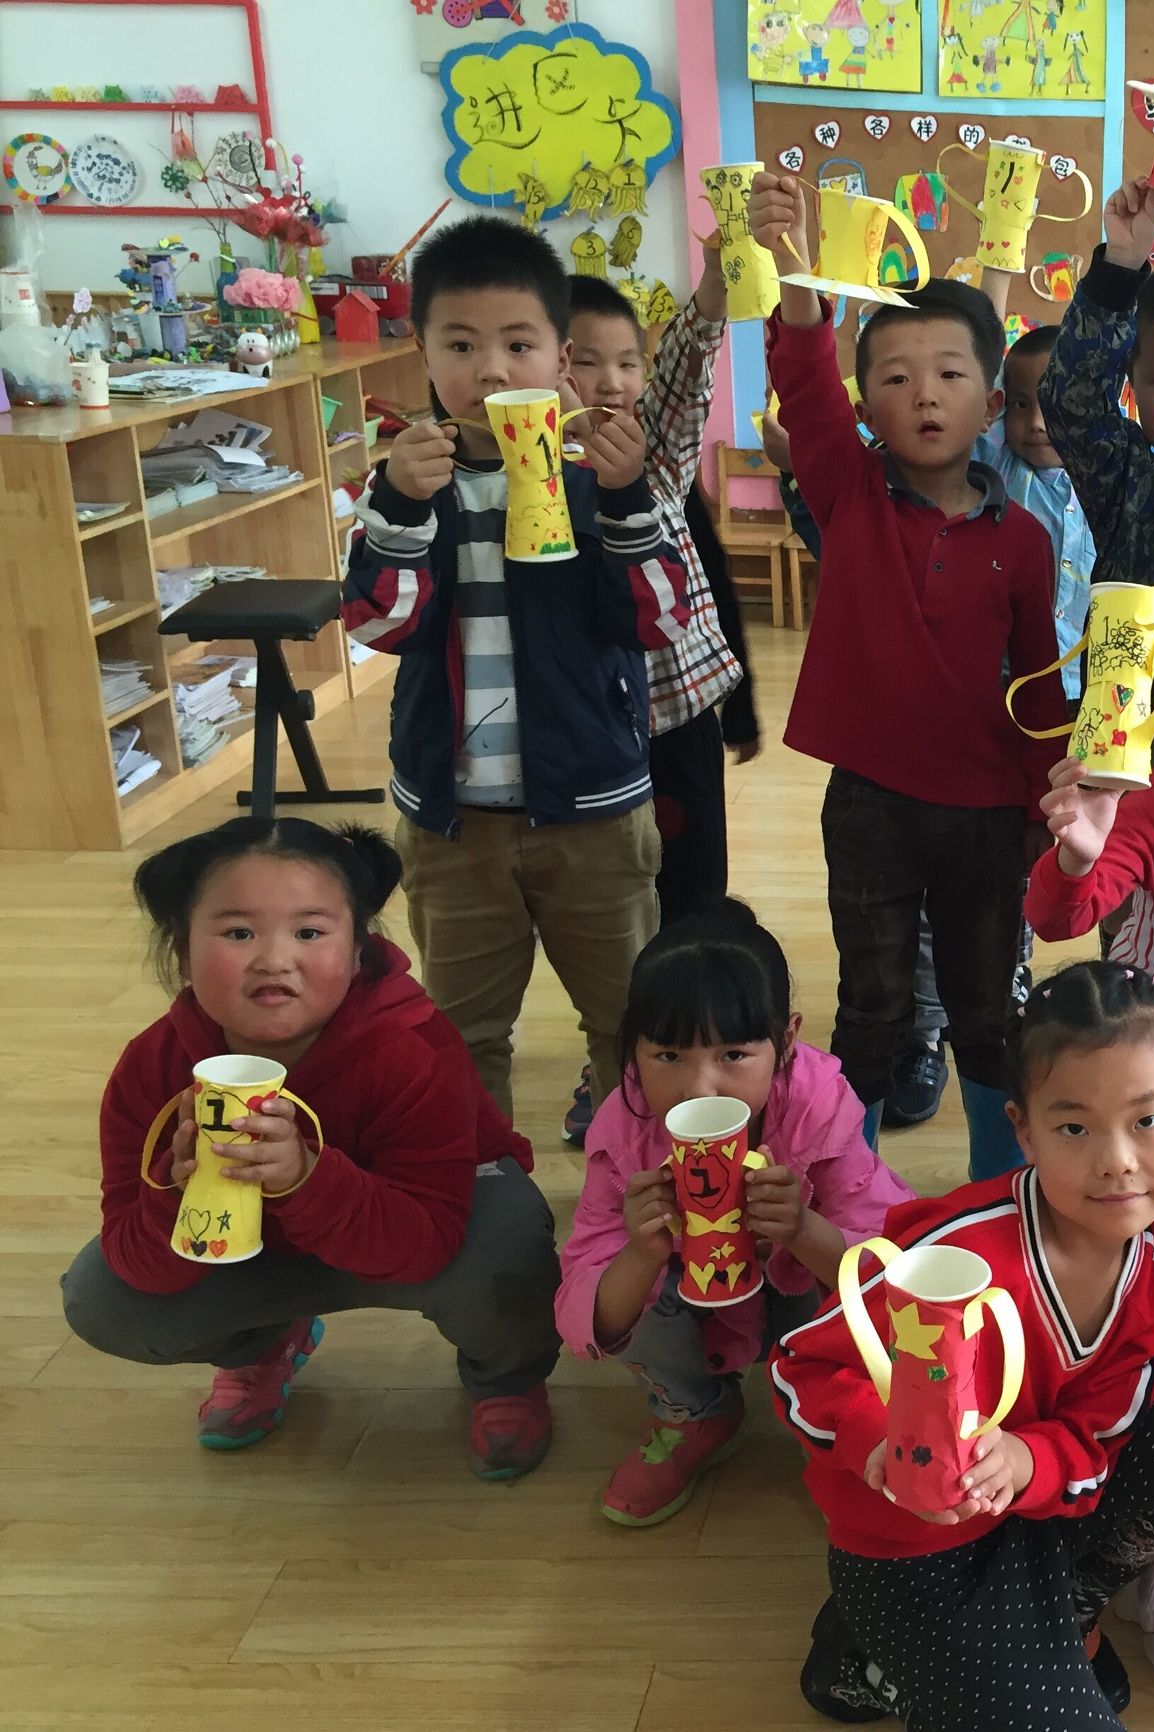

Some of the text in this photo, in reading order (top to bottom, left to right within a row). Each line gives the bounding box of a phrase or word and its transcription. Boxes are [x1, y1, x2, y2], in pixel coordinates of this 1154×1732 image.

[623, 173, 636, 186] 1
[585, 240, 597, 256] 3
[535, 432, 564, 483] 1
[201, 1098, 239, 1133] 1
[689, 1167, 722, 1197] 1
